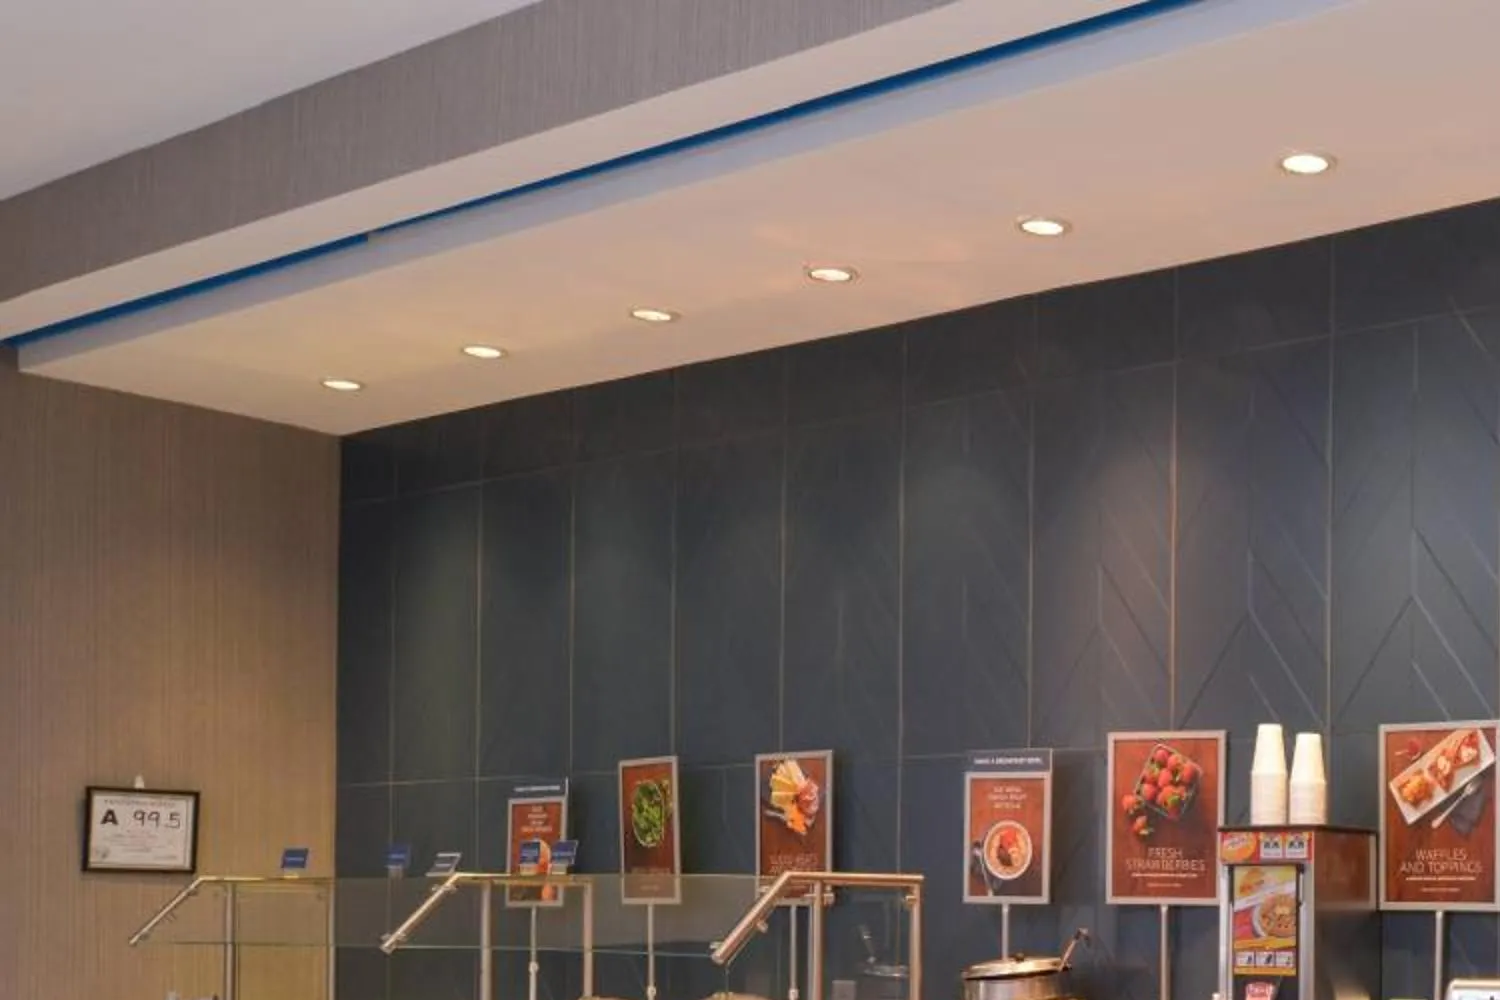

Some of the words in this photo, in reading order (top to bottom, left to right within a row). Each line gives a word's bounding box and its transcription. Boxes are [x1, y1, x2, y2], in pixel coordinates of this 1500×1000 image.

[101, 809, 119, 826] A
[1147, 847, 1184, 860] FRESH
[1415, 847, 1468, 861] WAFFLES
[1400, 861, 1425, 874] AND
[1427, 860, 1483, 874] TOPPINGS
